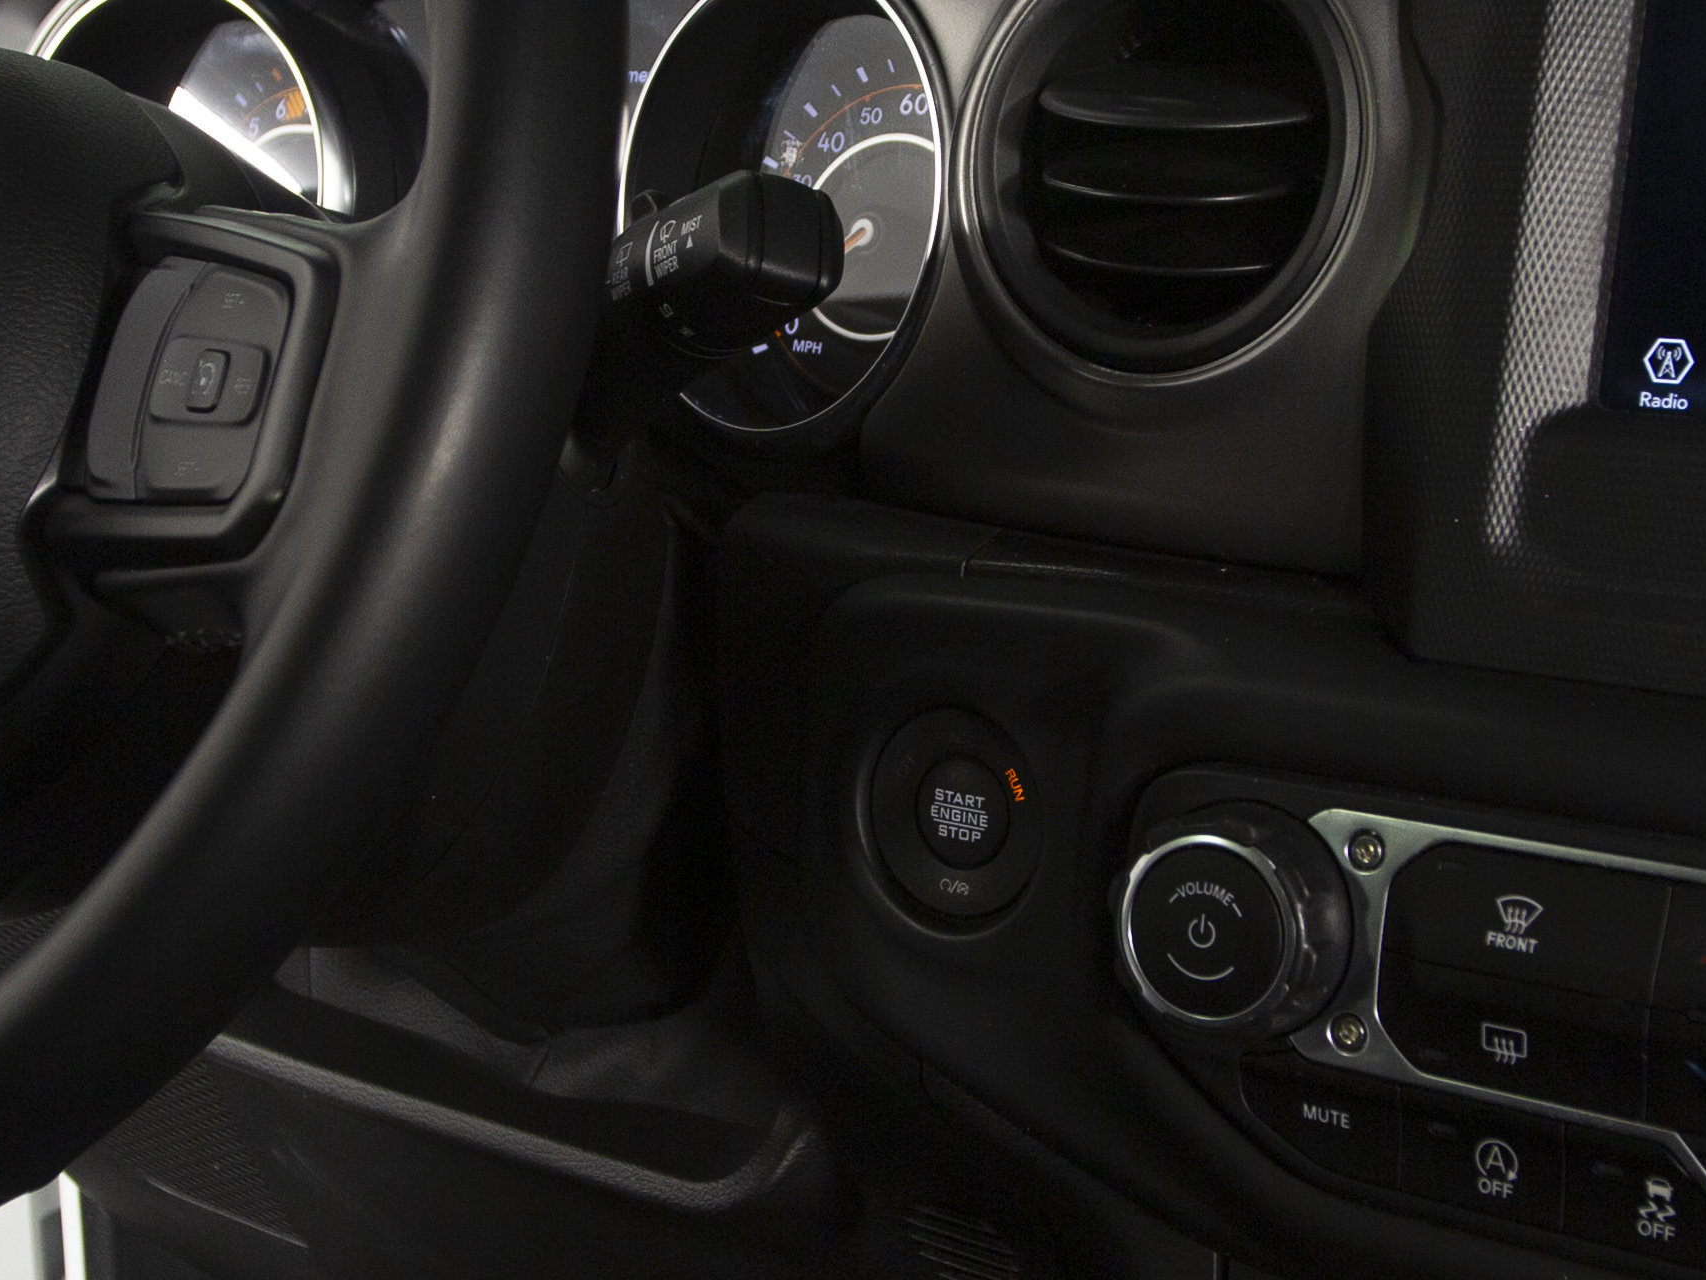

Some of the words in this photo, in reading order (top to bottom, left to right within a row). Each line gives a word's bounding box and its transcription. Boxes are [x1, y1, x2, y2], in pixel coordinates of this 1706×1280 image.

[275, 98, 287, 120] 6
[899, 93, 929, 115] 60
[248, 116, 260, 137] 5
[859, 106, 882, 125] 50
[816, 131, 845, 153] 40
[680, 214, 703, 236] MIST
[653, 239, 678, 262] FRONT
[654, 255, 680, 279] WIPER
[792, 339, 823, 355] MPH
[1639, 391, 1689, 410] Radio
[1004, 768, 1025, 803] RUN
[934, 788, 985, 809] START
[930, 806, 989, 828] ENGINE
[938, 824, 981, 843] STOP
[1176, 880, 1236, 908] VOLUME
[1485, 931, 1539, 954] FRONT
[1302, 1102, 1351, 1129] MUTE
[1477, 1177, 1514, 1199] OFF
[1636, 1218, 1676, 1241] OFF
